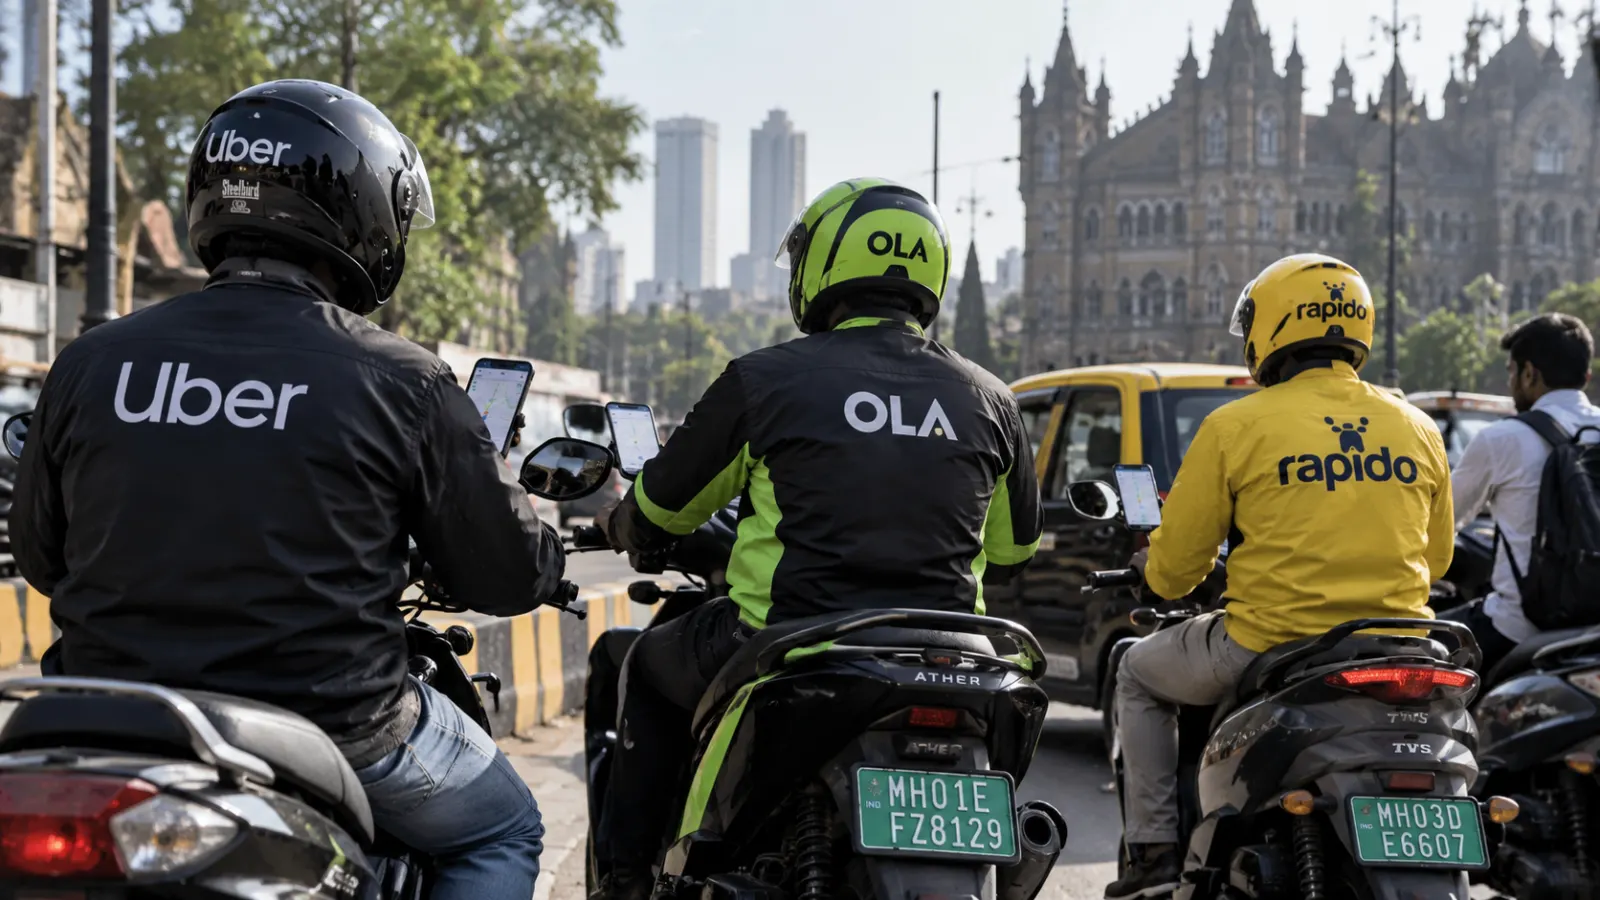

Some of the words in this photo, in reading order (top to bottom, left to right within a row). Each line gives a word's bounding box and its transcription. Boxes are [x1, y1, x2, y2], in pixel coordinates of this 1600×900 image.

[205, 129, 292, 167] Uber
[867, 230, 928, 263] OLA
[1296, 299, 1367, 323] rapido
[114, 361, 309, 431] Uber
[843, 391, 959, 441] OLA
[1278, 446, 1418, 491] rapido
[914, 671, 980, 686] ATHER
[1392, 742, 1432, 754] TVS
[888, 775, 990, 813] MH01E
[890, 812, 1002, 849] FZ8129
[1377, 802, 1462, 830] MH03D
[1382, 831, 1464, 859] E6607
